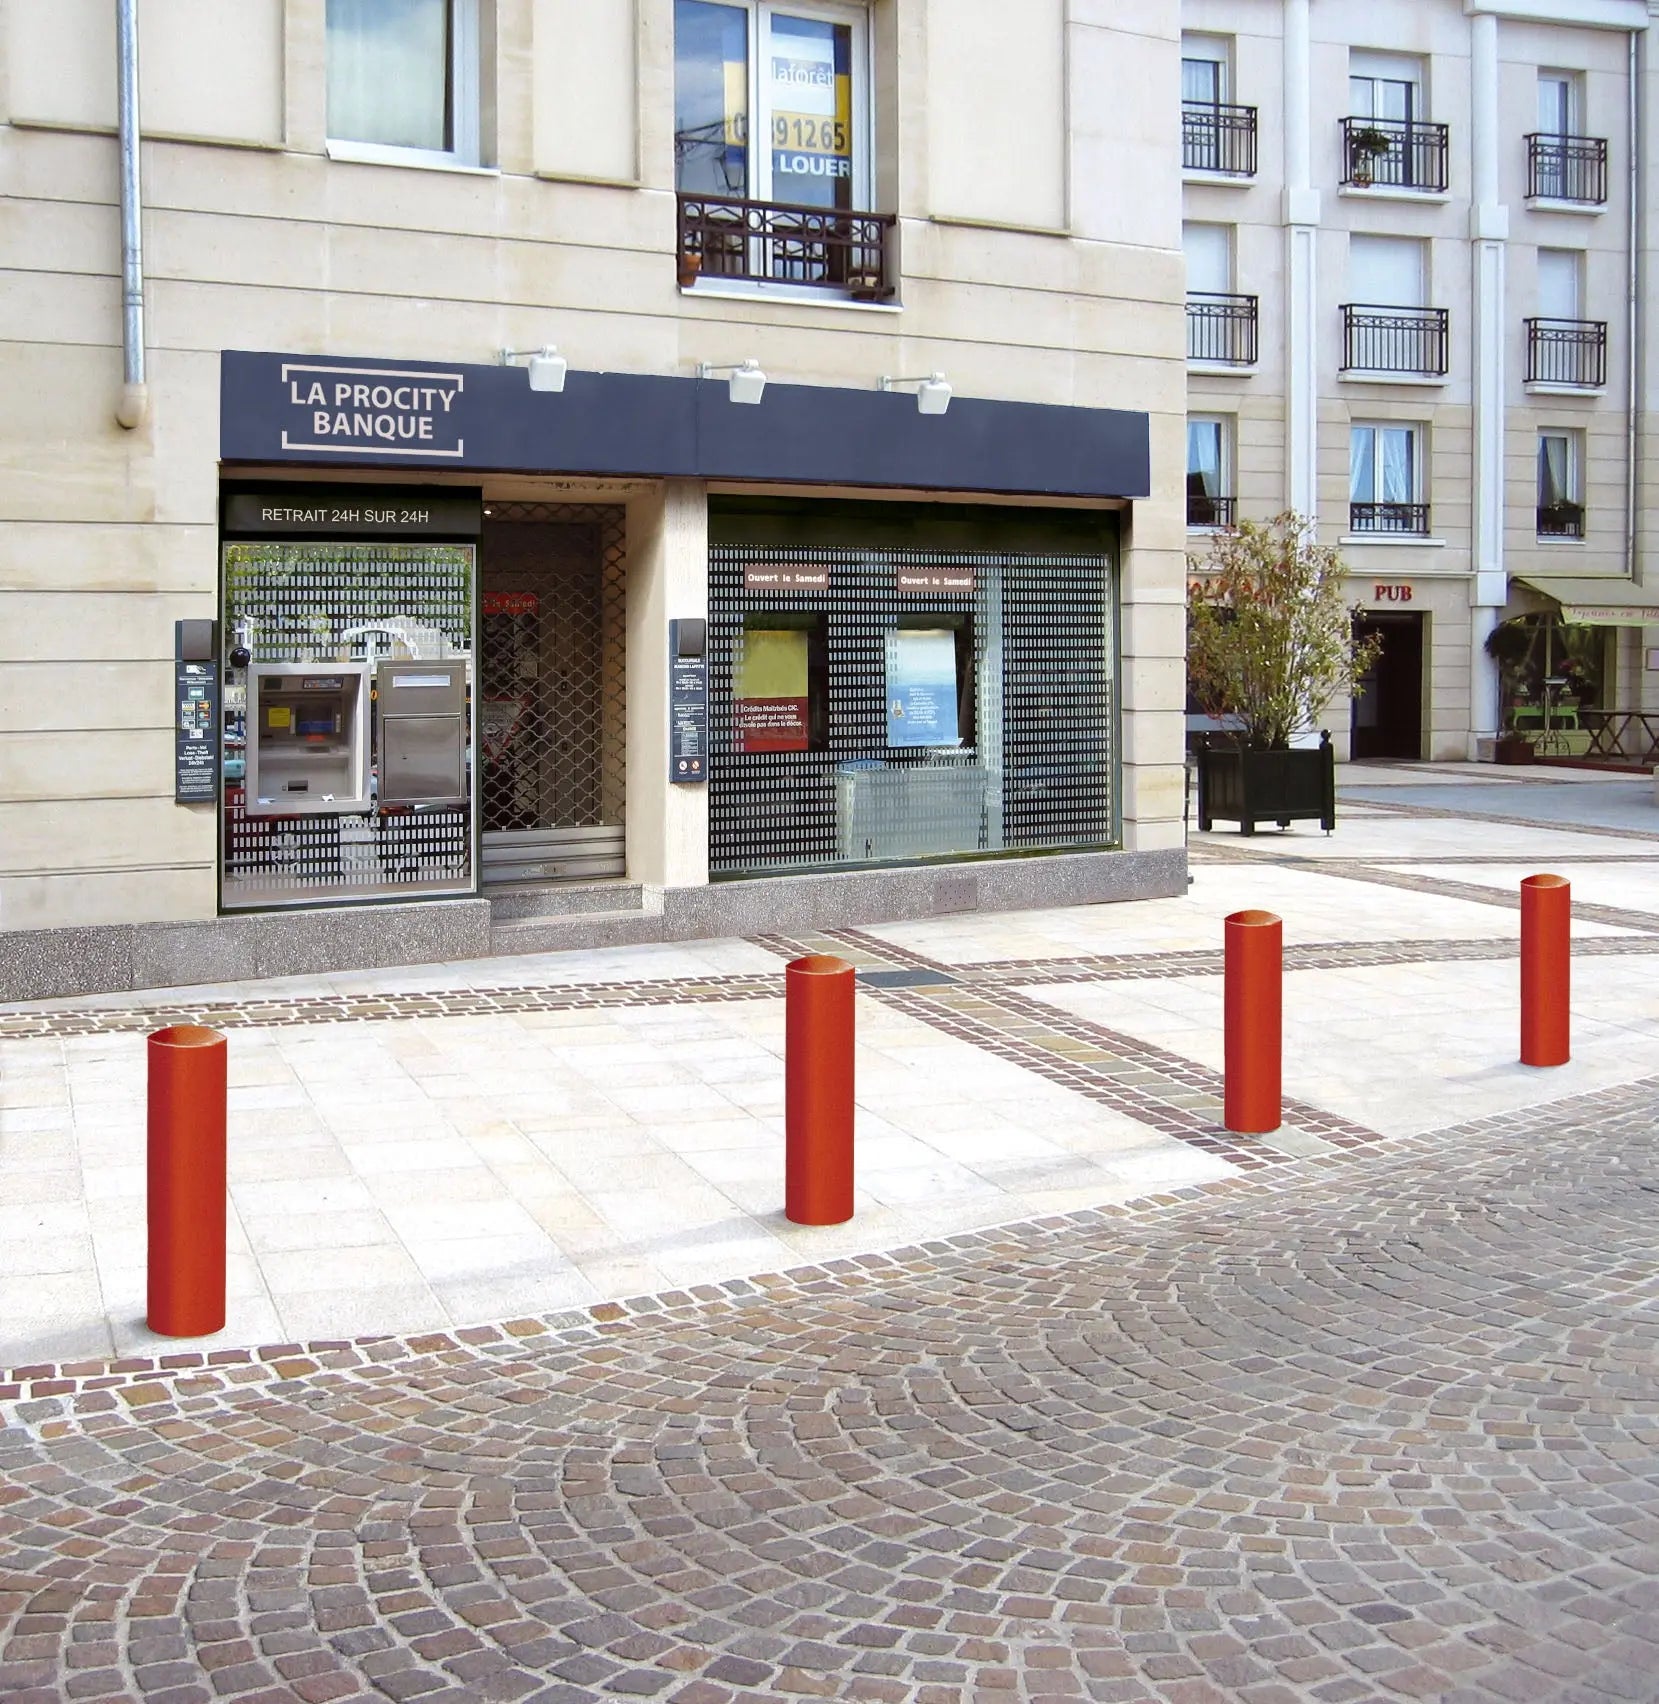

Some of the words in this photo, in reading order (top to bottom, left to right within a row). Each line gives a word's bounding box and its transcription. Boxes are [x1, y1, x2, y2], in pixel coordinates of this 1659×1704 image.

[780, 154, 851, 177] LOUER
[291, 381, 327, 406] LA
[335, 383, 456, 412] PROCITY
[313, 411, 434, 441] BANQUE
[262, 508, 327, 522] RETRAIT
[331, 509, 360, 522] 24H
[364, 509, 396, 523] SUR
[400, 510, 429, 523] 24H
[747, 573, 778, 583] Ouvert
[782, 573, 791, 583] le
[795, 573, 826, 583] Samedi
[900, 576, 929, 585] Ouvert
[932, 577, 940, 585] le
[943, 577, 971, 586] Samedi
[1374, 585, 1413, 601] PUB
